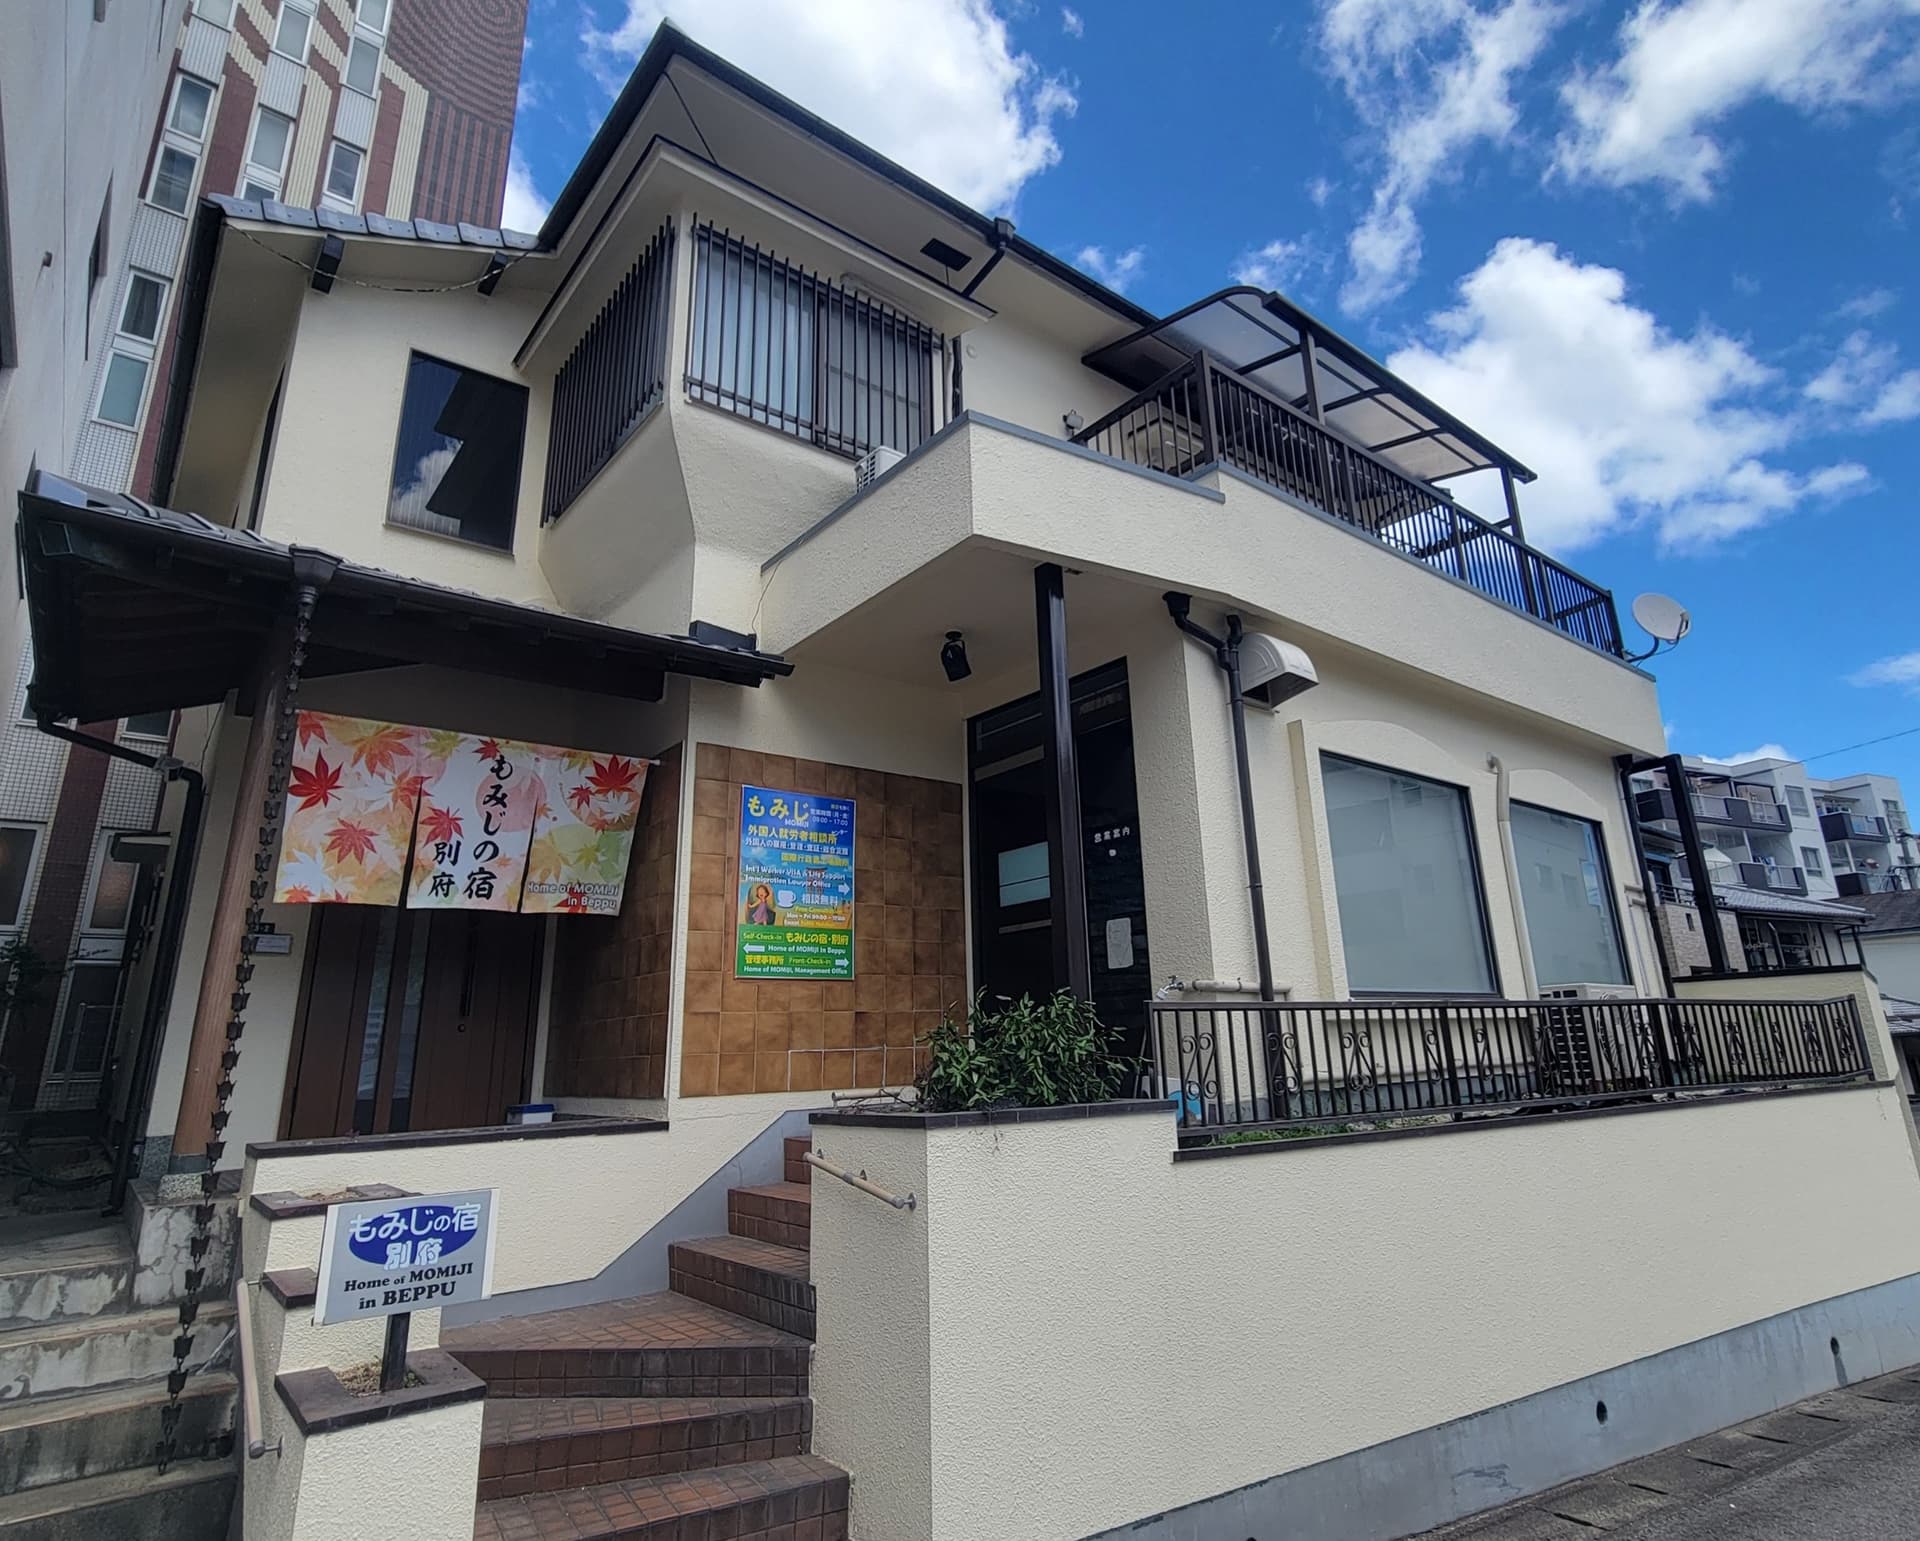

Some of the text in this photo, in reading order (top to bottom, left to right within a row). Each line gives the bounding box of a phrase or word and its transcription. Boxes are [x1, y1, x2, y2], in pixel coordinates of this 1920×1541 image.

[747, 795, 810, 821] もみじ
[464, 754, 513, 900] もみじの宿
[428, 840, 462, 898] 別府
[745, 875, 787, 886] Immigration
[527, 881, 619, 896] Home of MOMIJI
[567, 896, 617, 910] in Beppu
[768, 945, 787, 953] Home
[788, 945, 795, 953] of
[796, 945, 819, 954] MOMIJI
[827, 947, 846, 955] Beppu
[744, 965, 762, 973] Home
[763, 965, 770, 973] of
[795, 967, 830, 975] Management
[831, 967, 847, 975] Office
[349, 1203, 481, 1243] もみじの宿
[383, 1238, 443, 1271] 別府
[343, 1262, 473, 1292] Home of MOMIJI
[358, 1281, 457, 1310] in BEPPU
